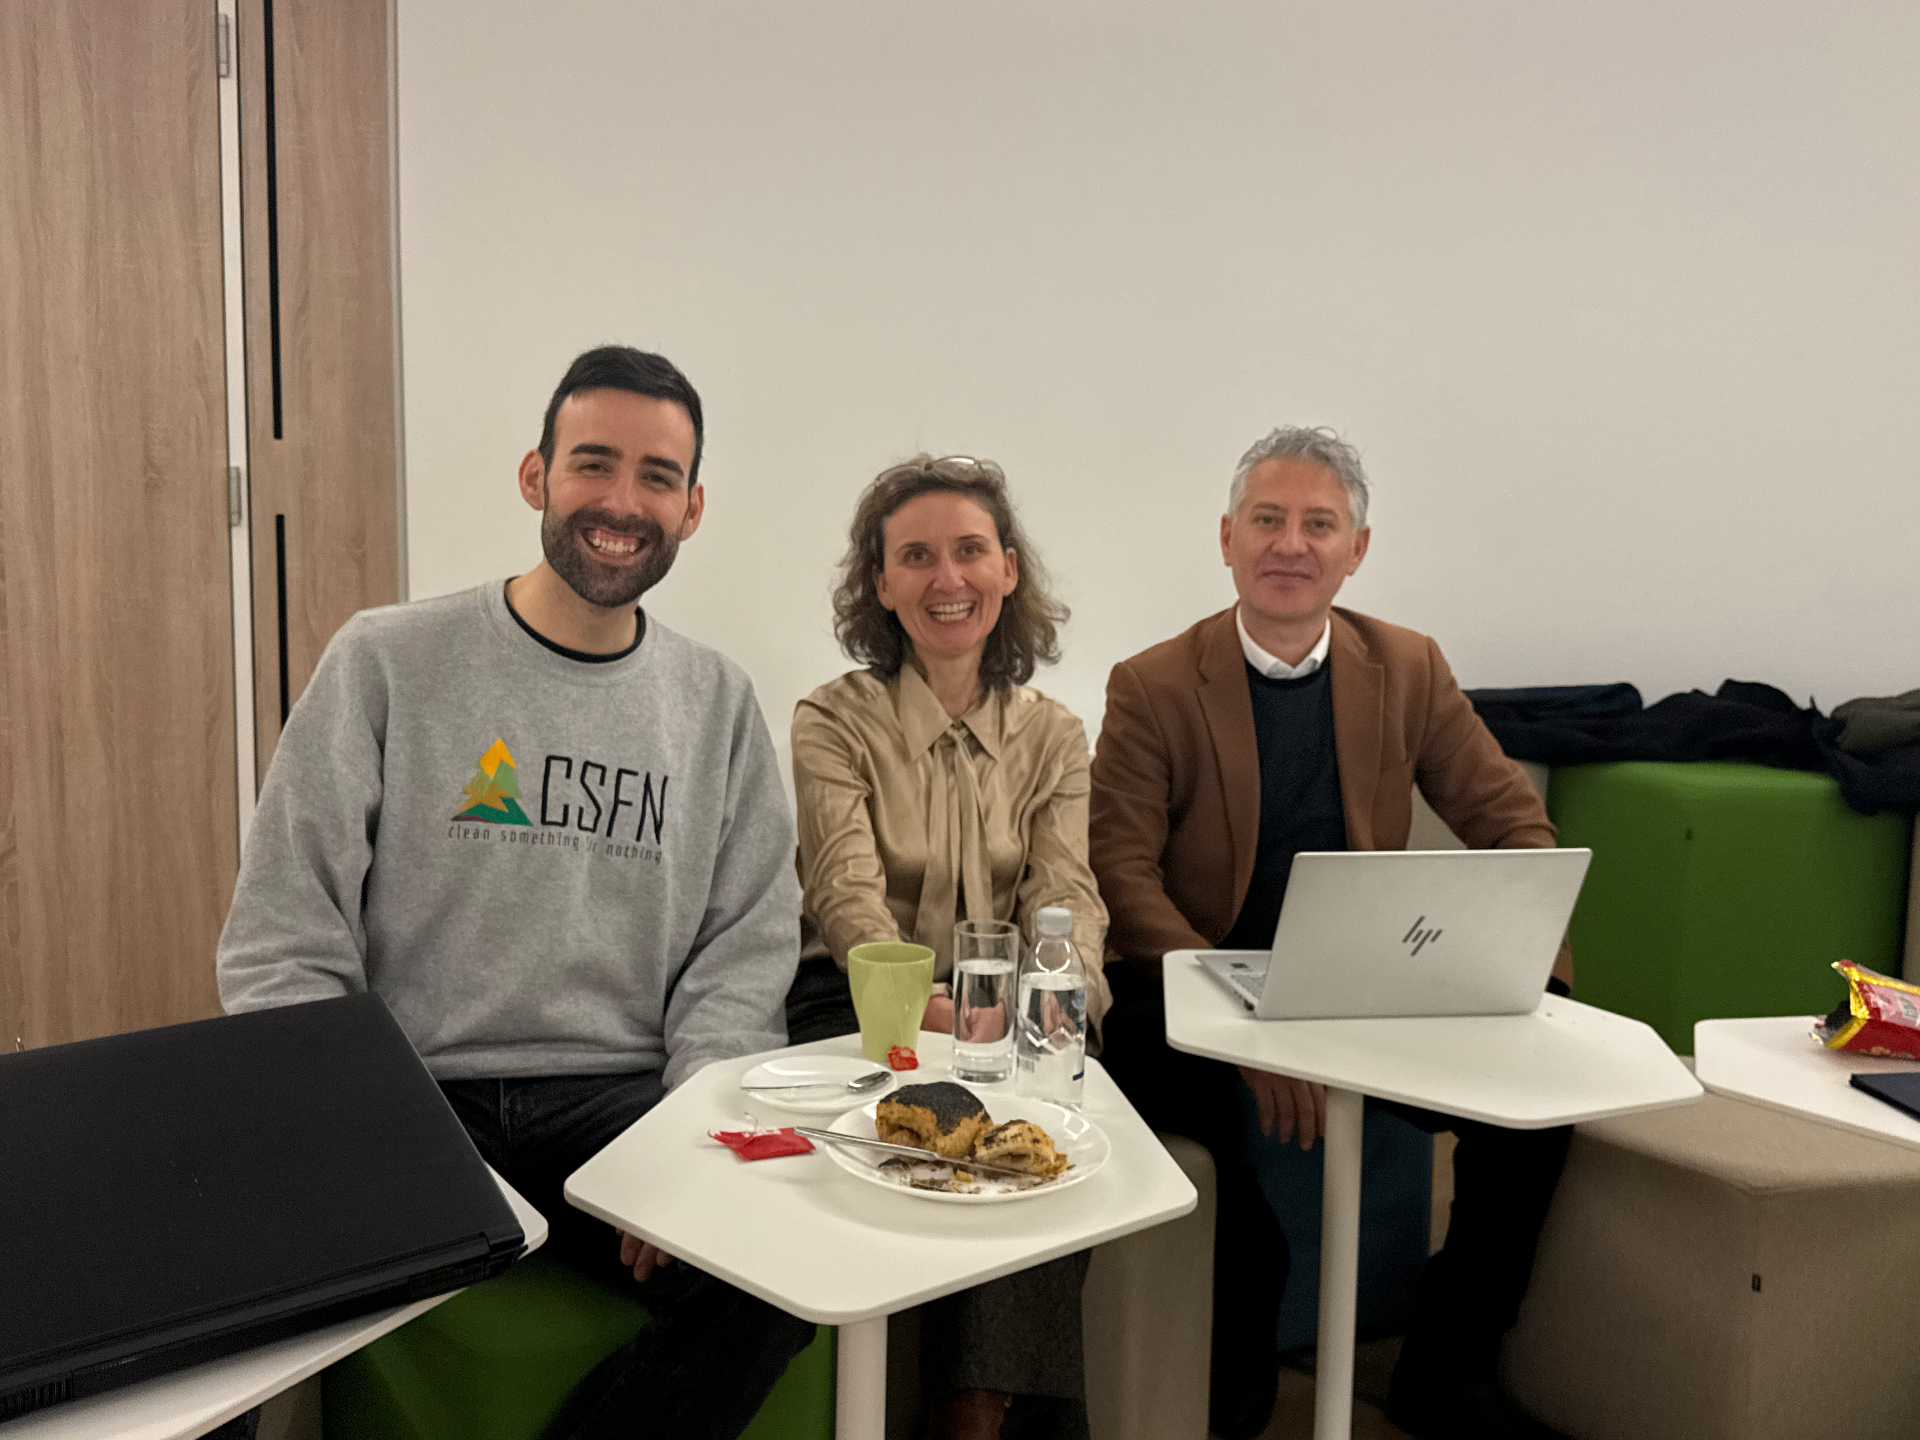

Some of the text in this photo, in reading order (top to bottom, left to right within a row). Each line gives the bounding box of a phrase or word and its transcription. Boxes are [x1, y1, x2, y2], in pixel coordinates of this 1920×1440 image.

[540, 754, 669, 845] CSFN
[448, 824, 490, 841] clean
[501, 829, 580, 852] something
[606, 843, 663, 866] nothing
